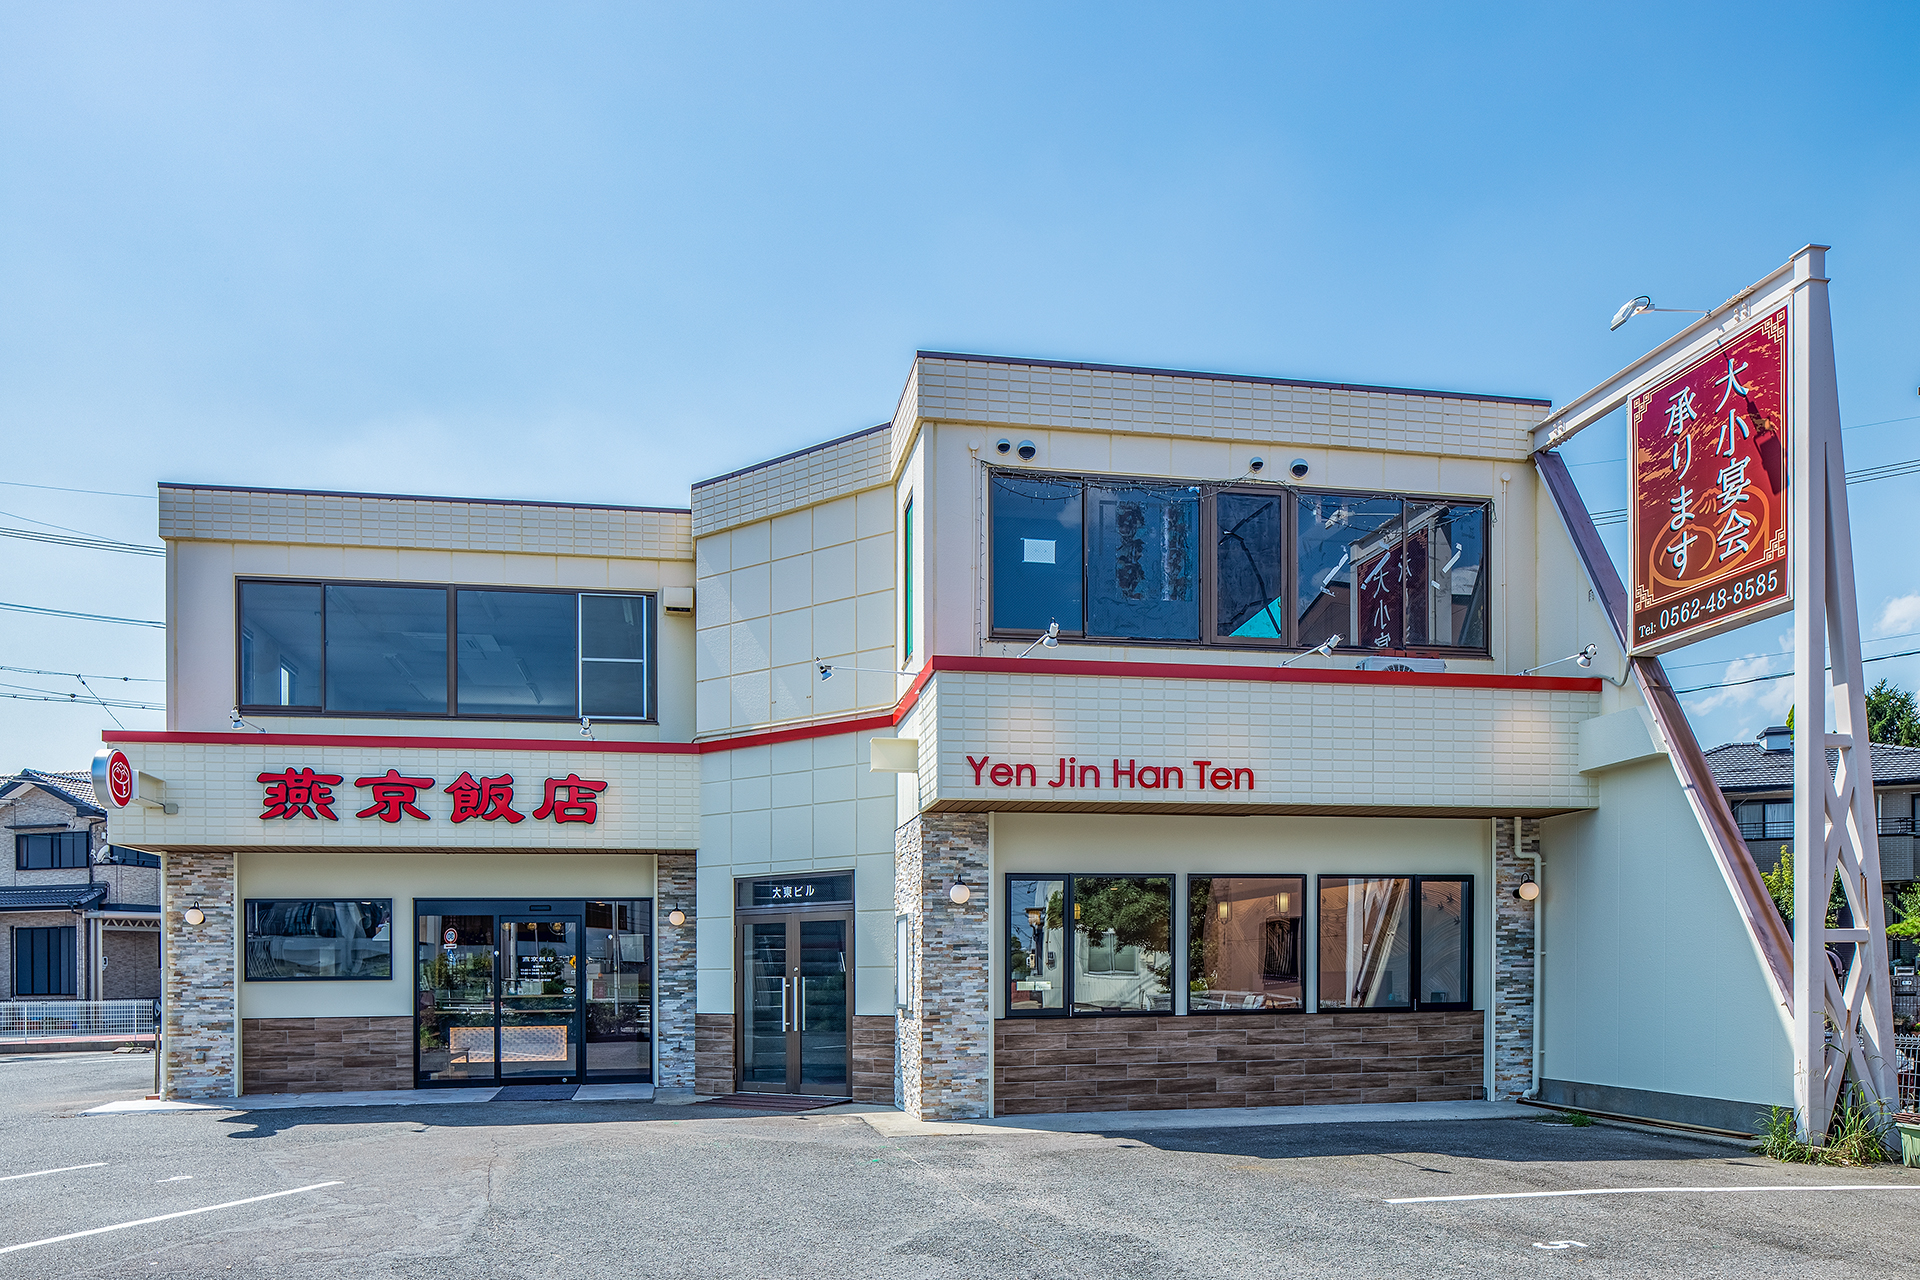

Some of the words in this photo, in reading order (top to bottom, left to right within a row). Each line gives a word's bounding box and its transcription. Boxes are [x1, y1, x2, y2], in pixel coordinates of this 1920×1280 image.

[1664, 386, 1698, 579] 承ります
[1715, 358, 1751, 562] 大小宴会
[1638, 624, 1658, 638] Tel:
[1659, 569, 1778, 630] 0562-48-8585
[257, 767, 609, 824] 燕京飯店
[966, 755, 1037, 786] Yen
[1048, 757, 1101, 788] Jin
[1113, 759, 1184, 789] Han
[1193, 760, 1255, 790] Ten
[772, 885, 815, 898] 大東ビル
